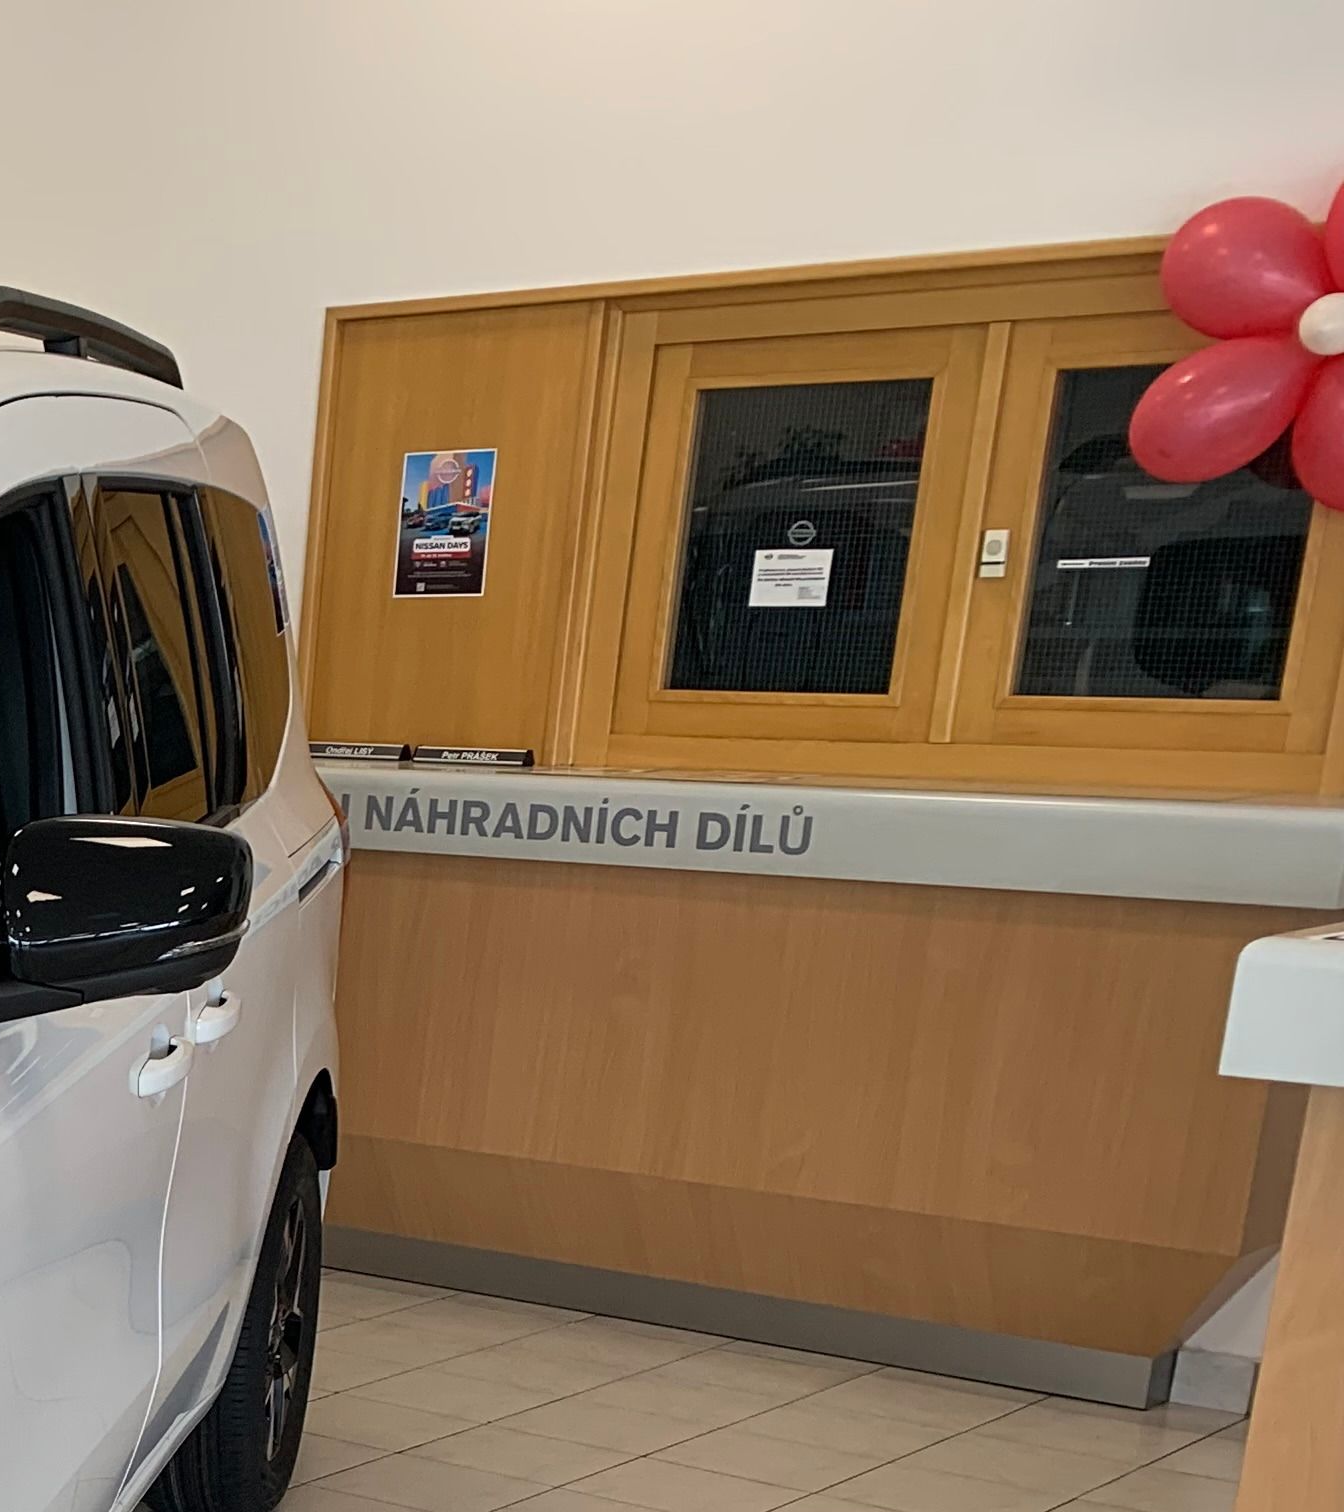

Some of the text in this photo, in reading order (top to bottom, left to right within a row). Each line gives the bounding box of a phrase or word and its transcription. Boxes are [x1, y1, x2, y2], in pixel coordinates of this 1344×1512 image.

[415, 541, 469, 550] NISSAN DAYS
[364, 787, 679, 848] NÁHRADNÍCH
[696, 804, 813, 856] DÍLŮ
